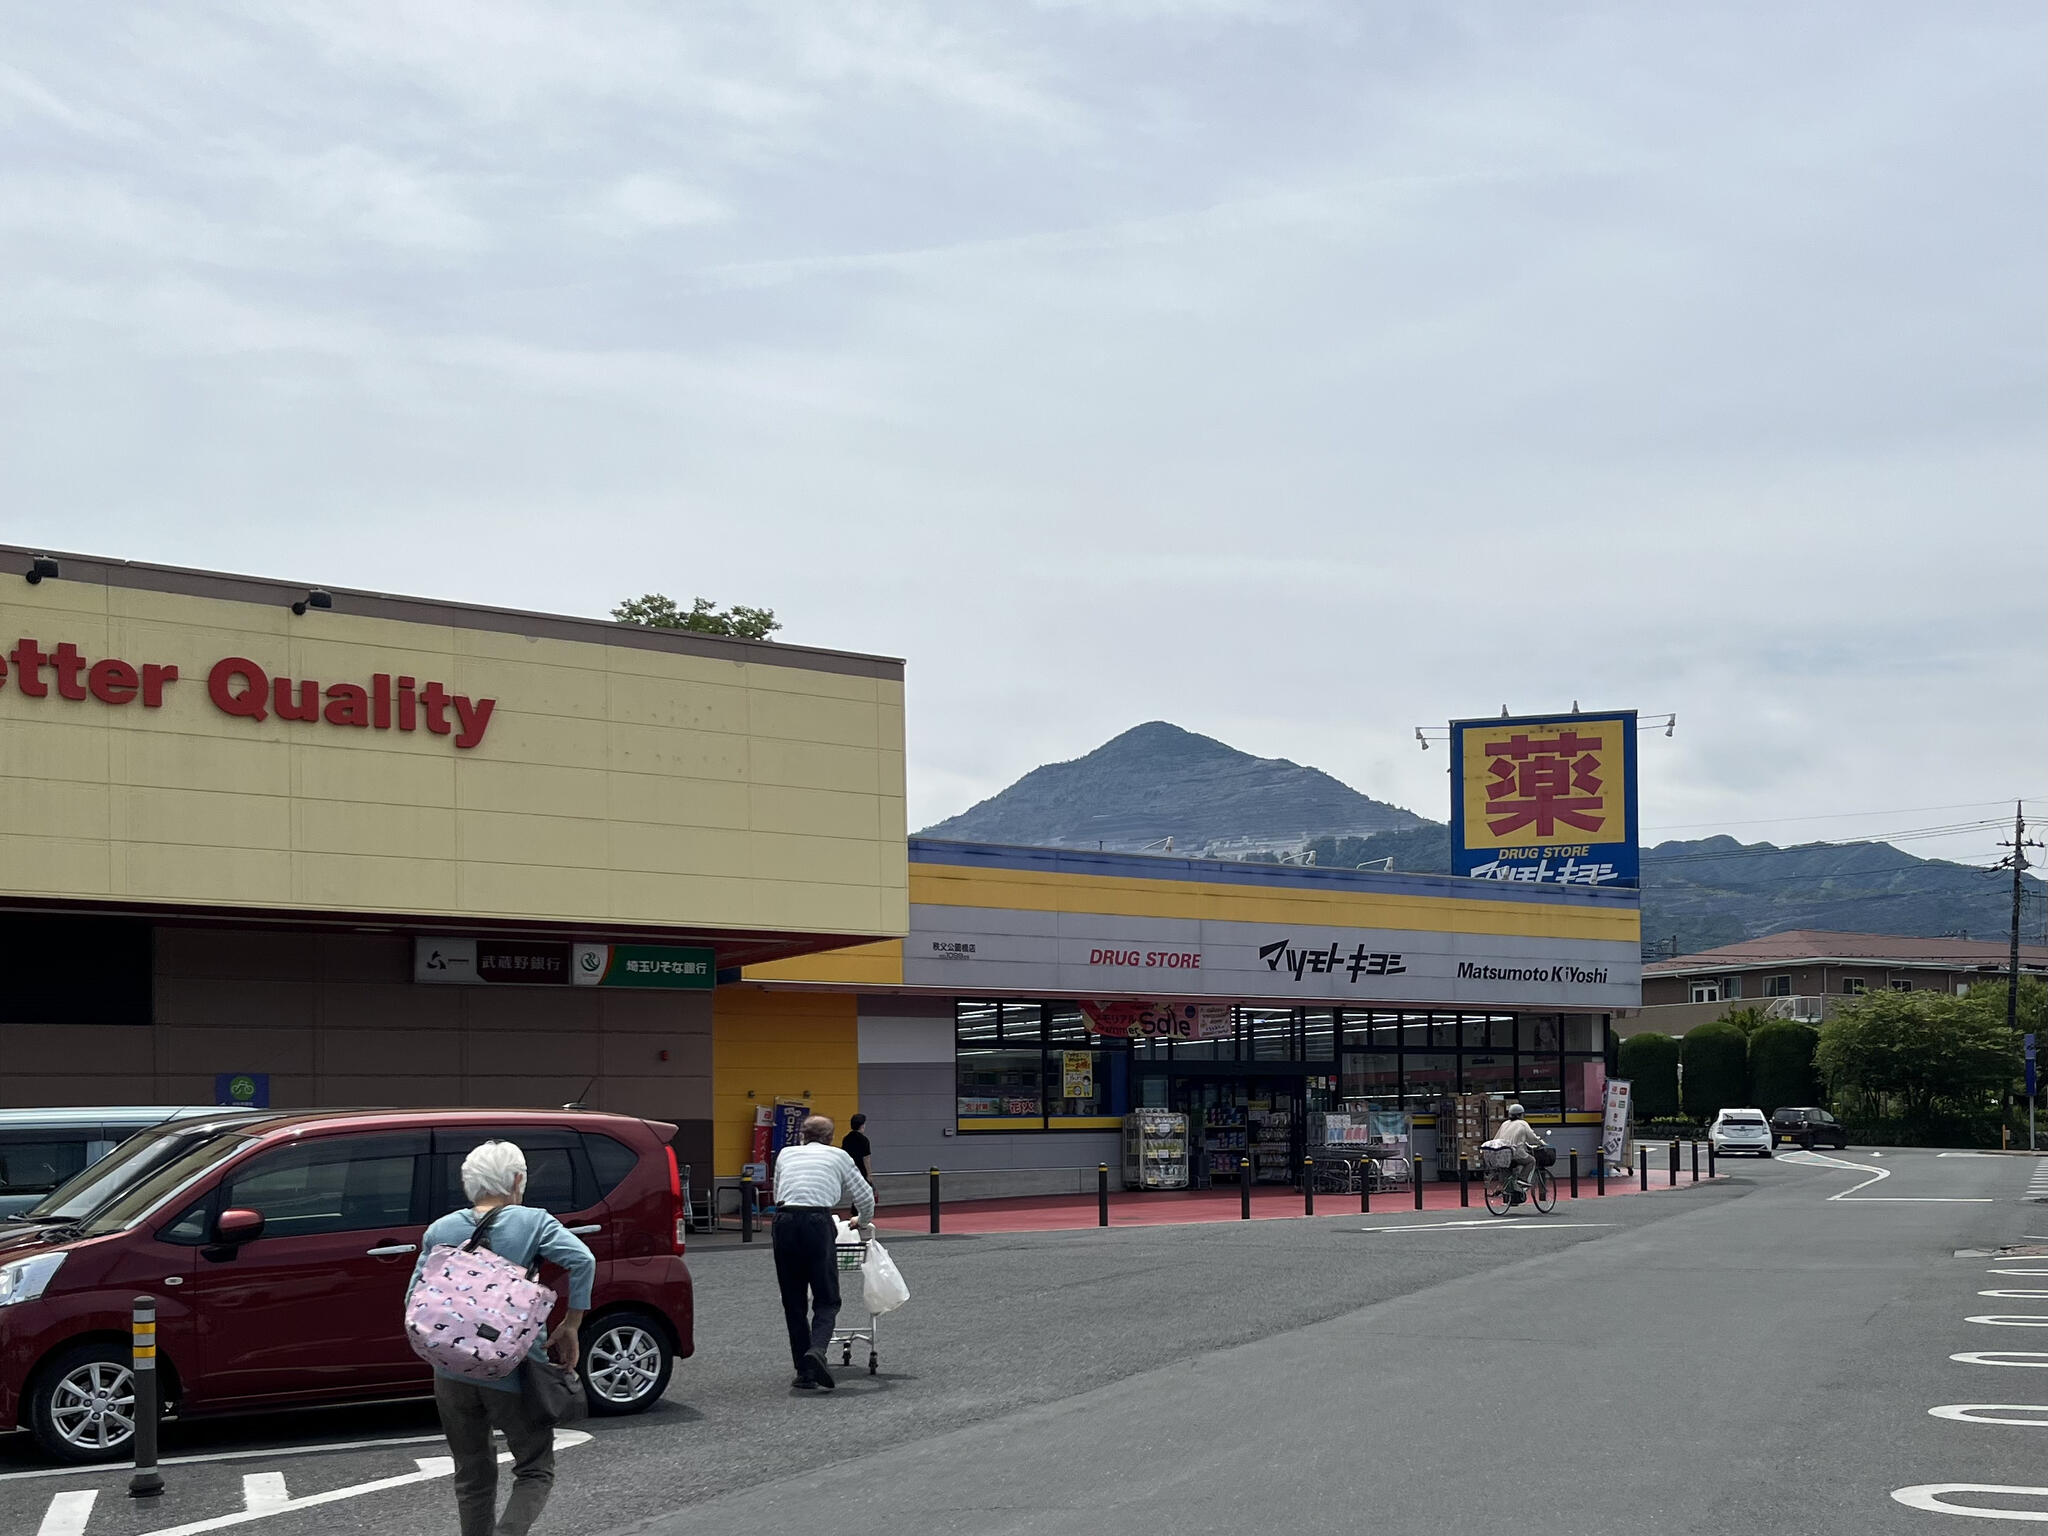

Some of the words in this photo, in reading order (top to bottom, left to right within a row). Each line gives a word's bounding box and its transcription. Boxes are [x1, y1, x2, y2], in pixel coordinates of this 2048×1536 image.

[0, 638, 178, 708] tter
[208, 657, 496, 748] Quality
[1485, 732, 1606, 837] 薬
[1498, 848, 1540, 860] DRUG
[1543, 845, 1590, 858] STORE
[480, 954, 561, 972] 武蔵野銀行
[625, 959, 707, 975] 埼玉りそな銀行
[1089, 949, 1140, 967] DRUG
[1145, 951, 1201, 969] STORE
[1259, 939, 1407, 983] マツモトキヨシ
[1457, 962, 1549, 982] Matsumoto
[1551, 966, 1608, 984] KiYoshi
[1139, 1006, 1191, 1036] Sale
[1009, 1101, 1034, 1114] 花火
